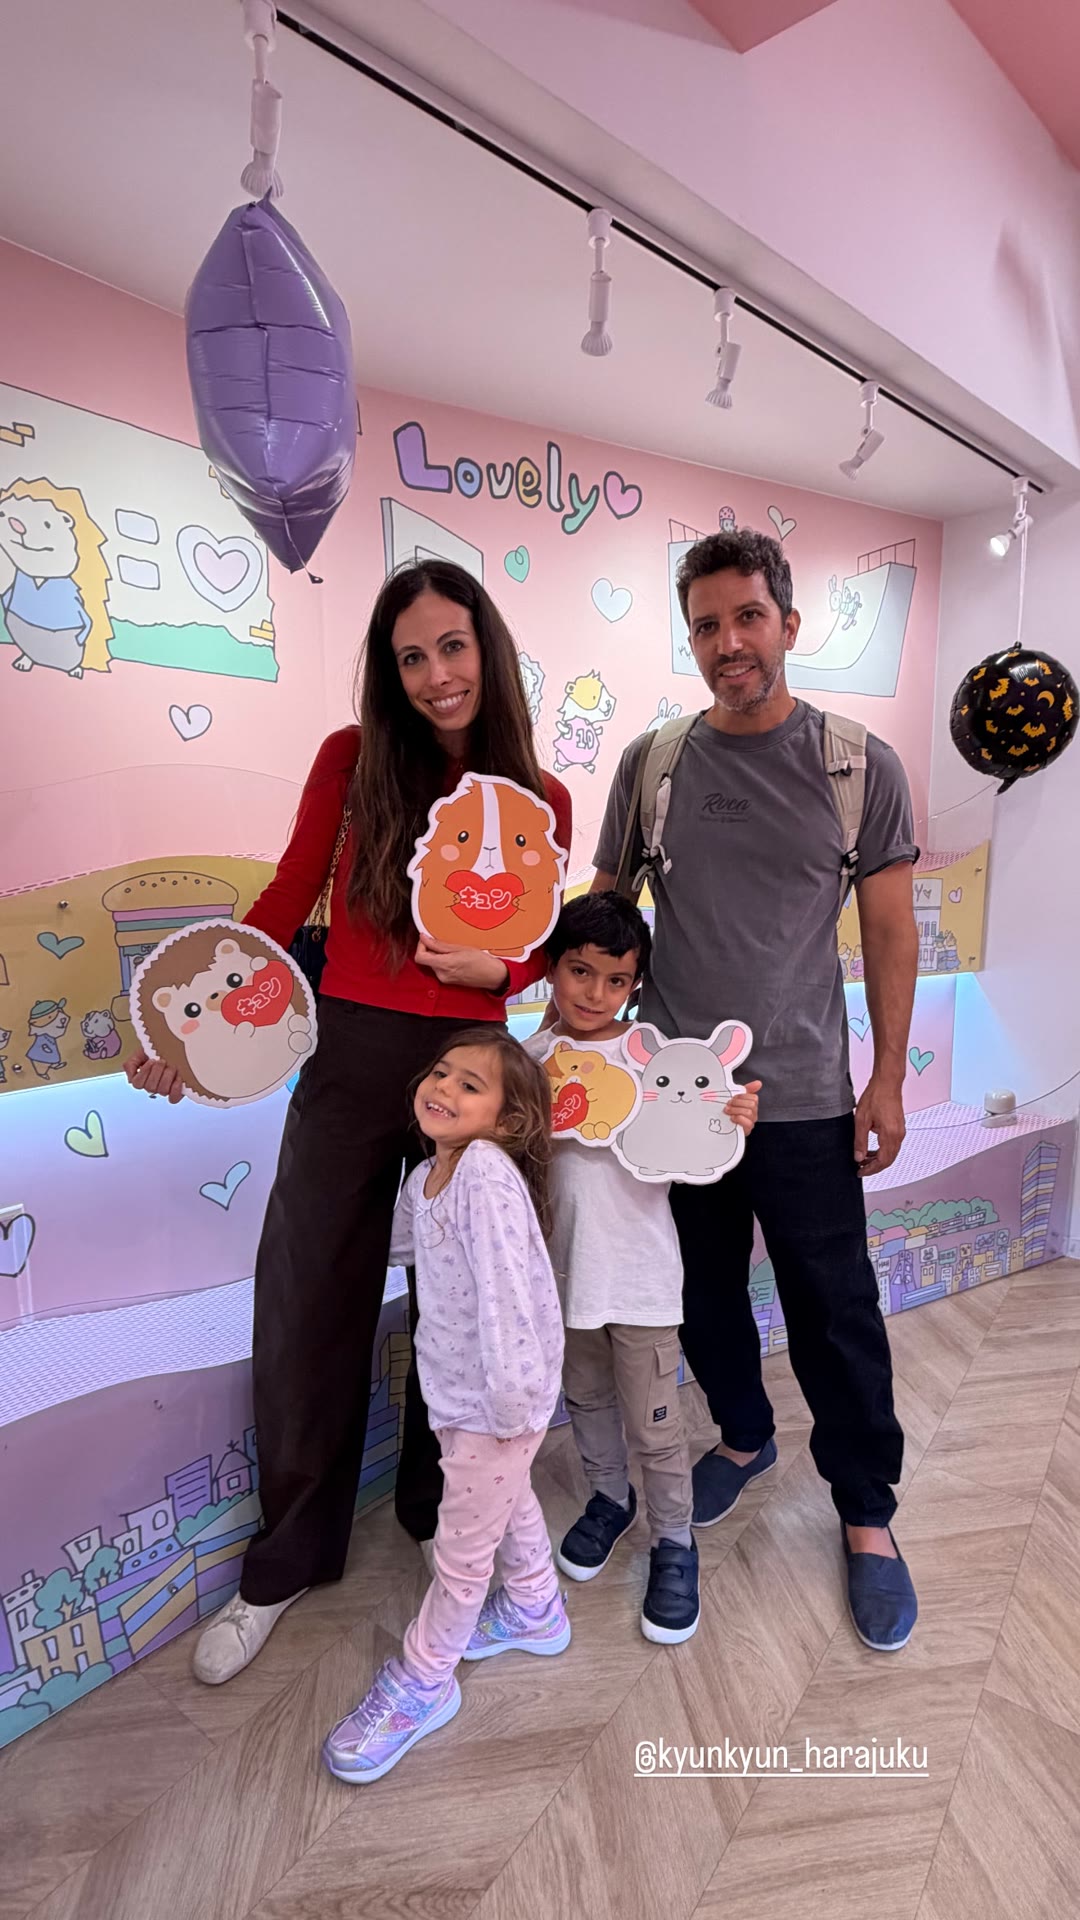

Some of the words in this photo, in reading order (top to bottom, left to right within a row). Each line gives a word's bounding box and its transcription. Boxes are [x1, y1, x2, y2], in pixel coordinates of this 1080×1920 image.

[393, 421, 600, 535] Lovely
[575, 727, 595, 750] 10
[459, 886, 512, 910] キュン
[237, 977, 282, 1016] キュン
